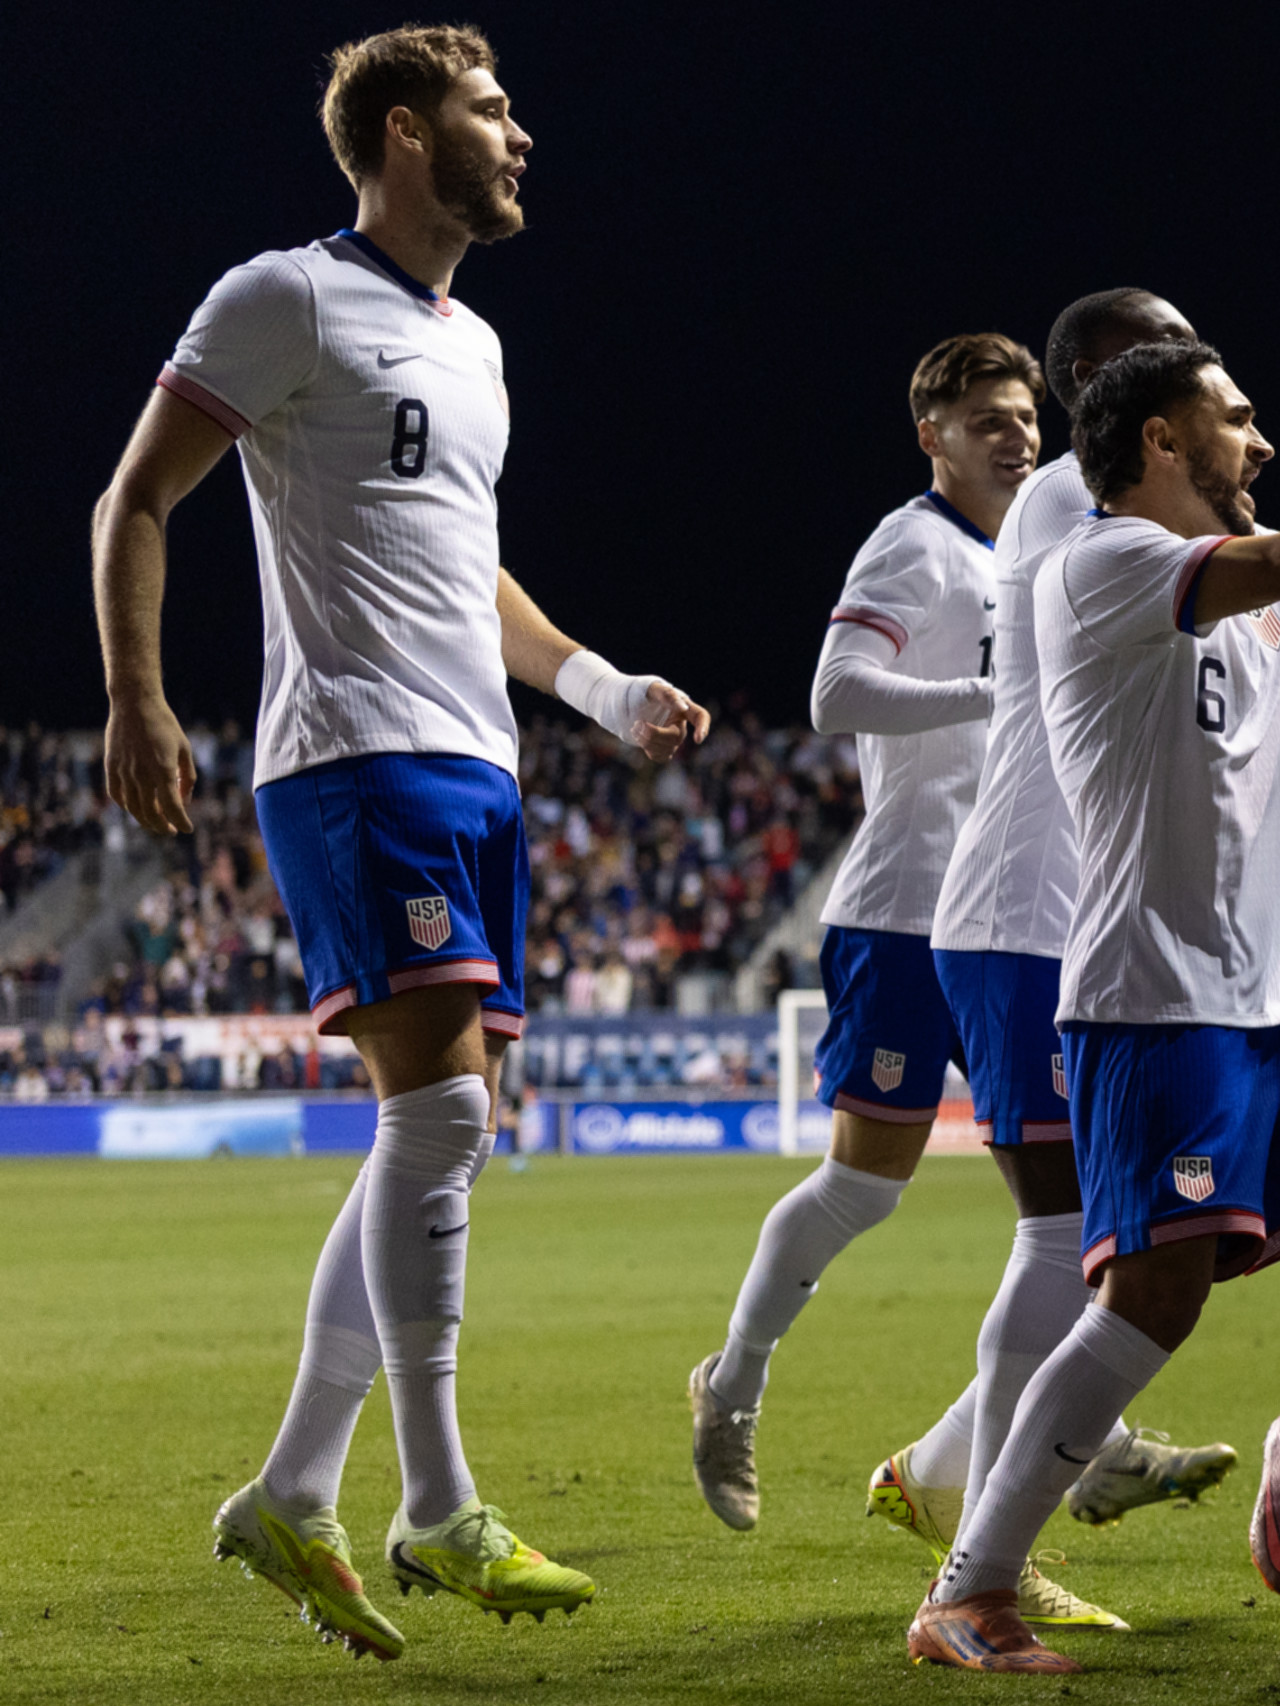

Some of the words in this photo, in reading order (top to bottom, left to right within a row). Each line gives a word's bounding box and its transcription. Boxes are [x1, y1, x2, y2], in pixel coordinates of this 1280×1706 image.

[391, 398, 429, 479] 8
[1197, 655, 1226, 734] 6
[408, 898, 446, 920] USA
[875, 1050, 903, 1069] USA
[1175, 1159, 1210, 1179] USA
